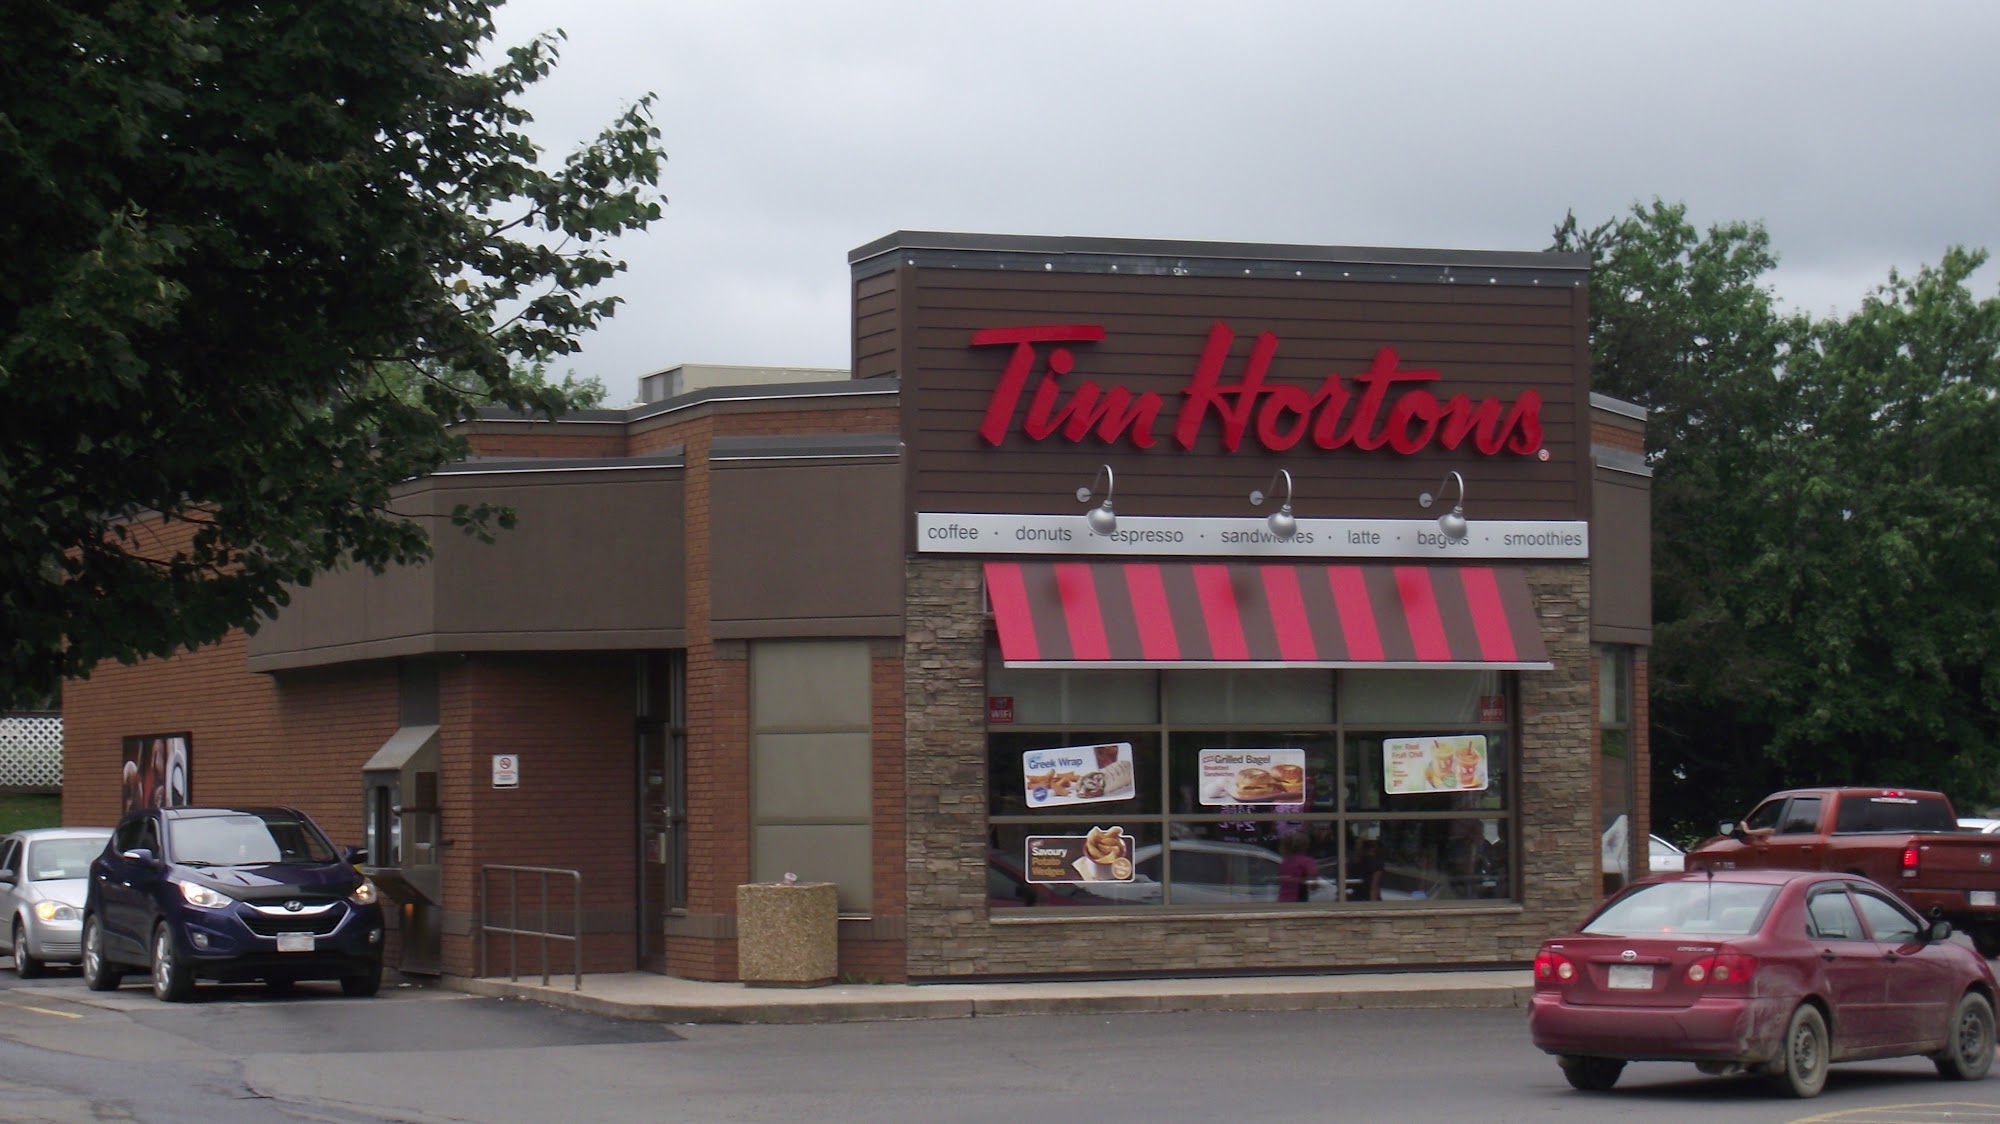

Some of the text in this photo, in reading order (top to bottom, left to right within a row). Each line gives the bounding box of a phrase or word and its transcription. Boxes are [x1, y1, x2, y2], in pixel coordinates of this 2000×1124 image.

[970, 320, 1543, 455] Tim Hortons
[928, 524, 979, 540] coffee
[1015, 525, 1073, 542] donuts
[1110, 530, 1184, 546] espresso
[1347, 529, 1381, 545] latte
[1417, 530, 1469, 549] bags
[1503, 530, 1583, 547] smoothies
[1029, 757, 1083, 770] Greek Wrap
[1215, 754, 1244, 764] Grilled
[1246, 754, 1271, 766] Bagel
[1032, 846, 1068, 858] Savoury
[1031, 856, 1061, 866] Potato
[1031, 867, 1066, 877] Wedges
